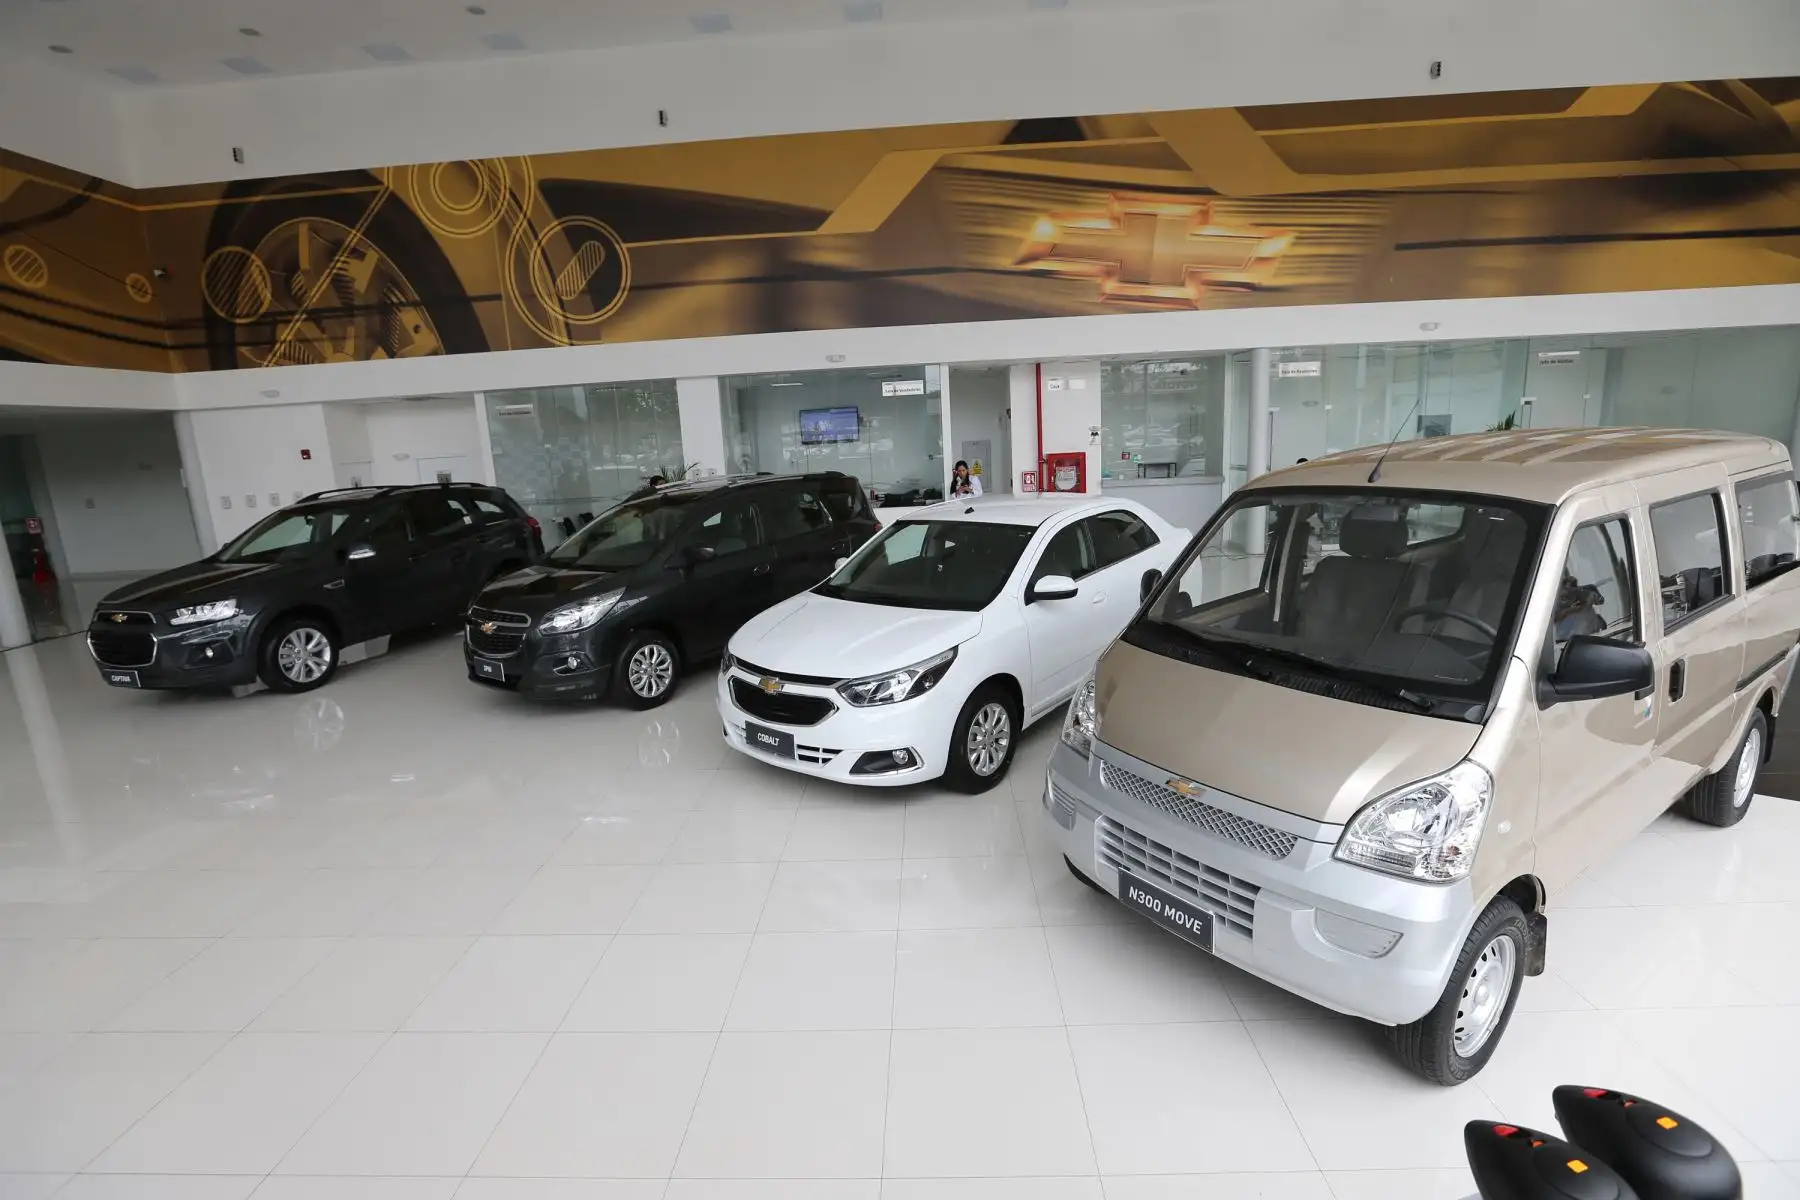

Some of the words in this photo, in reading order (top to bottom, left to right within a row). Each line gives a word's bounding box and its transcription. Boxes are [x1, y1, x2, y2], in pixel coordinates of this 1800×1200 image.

[757, 732, 780, 746] COBALT
[1129, 886, 1161, 912] N300
[1164, 904, 1203, 935] MOVE
